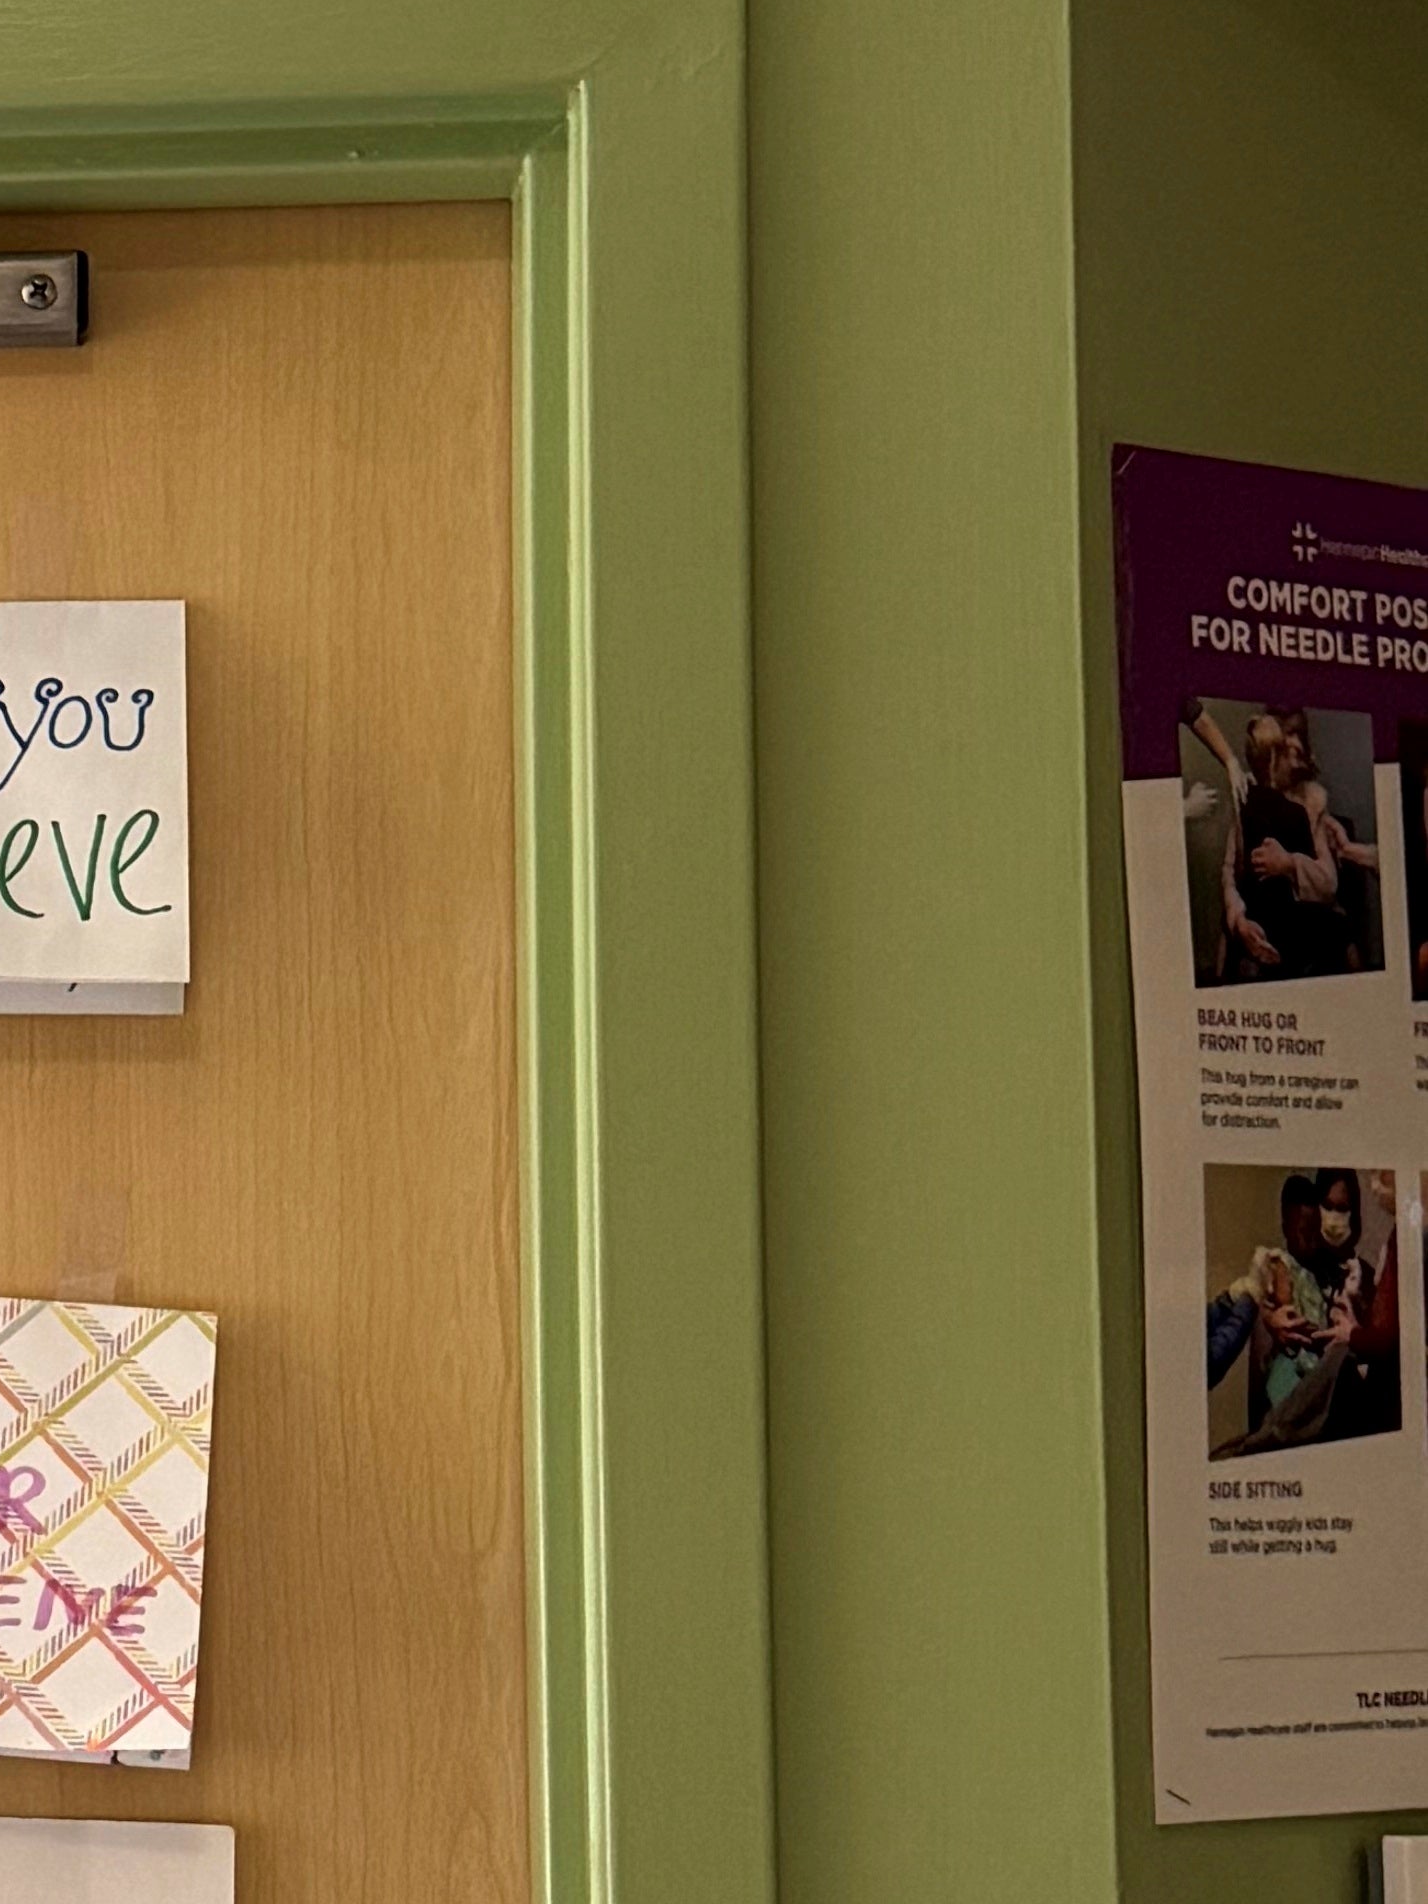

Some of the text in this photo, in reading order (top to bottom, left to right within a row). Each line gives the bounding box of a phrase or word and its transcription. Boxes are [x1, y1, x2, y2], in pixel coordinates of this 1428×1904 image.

[1227, 575, 1368, 624] COMFORT
[1191, 615, 1371, 666] FOR NEEDLE
[1197, 1009, 1236, 1026] BEAR
[1241, 1012, 1272, 1029] HUG
[1199, 1034, 1325, 1056] FRONT TO FRONT
[1209, 1482, 1303, 1498] SIDE SITTING
